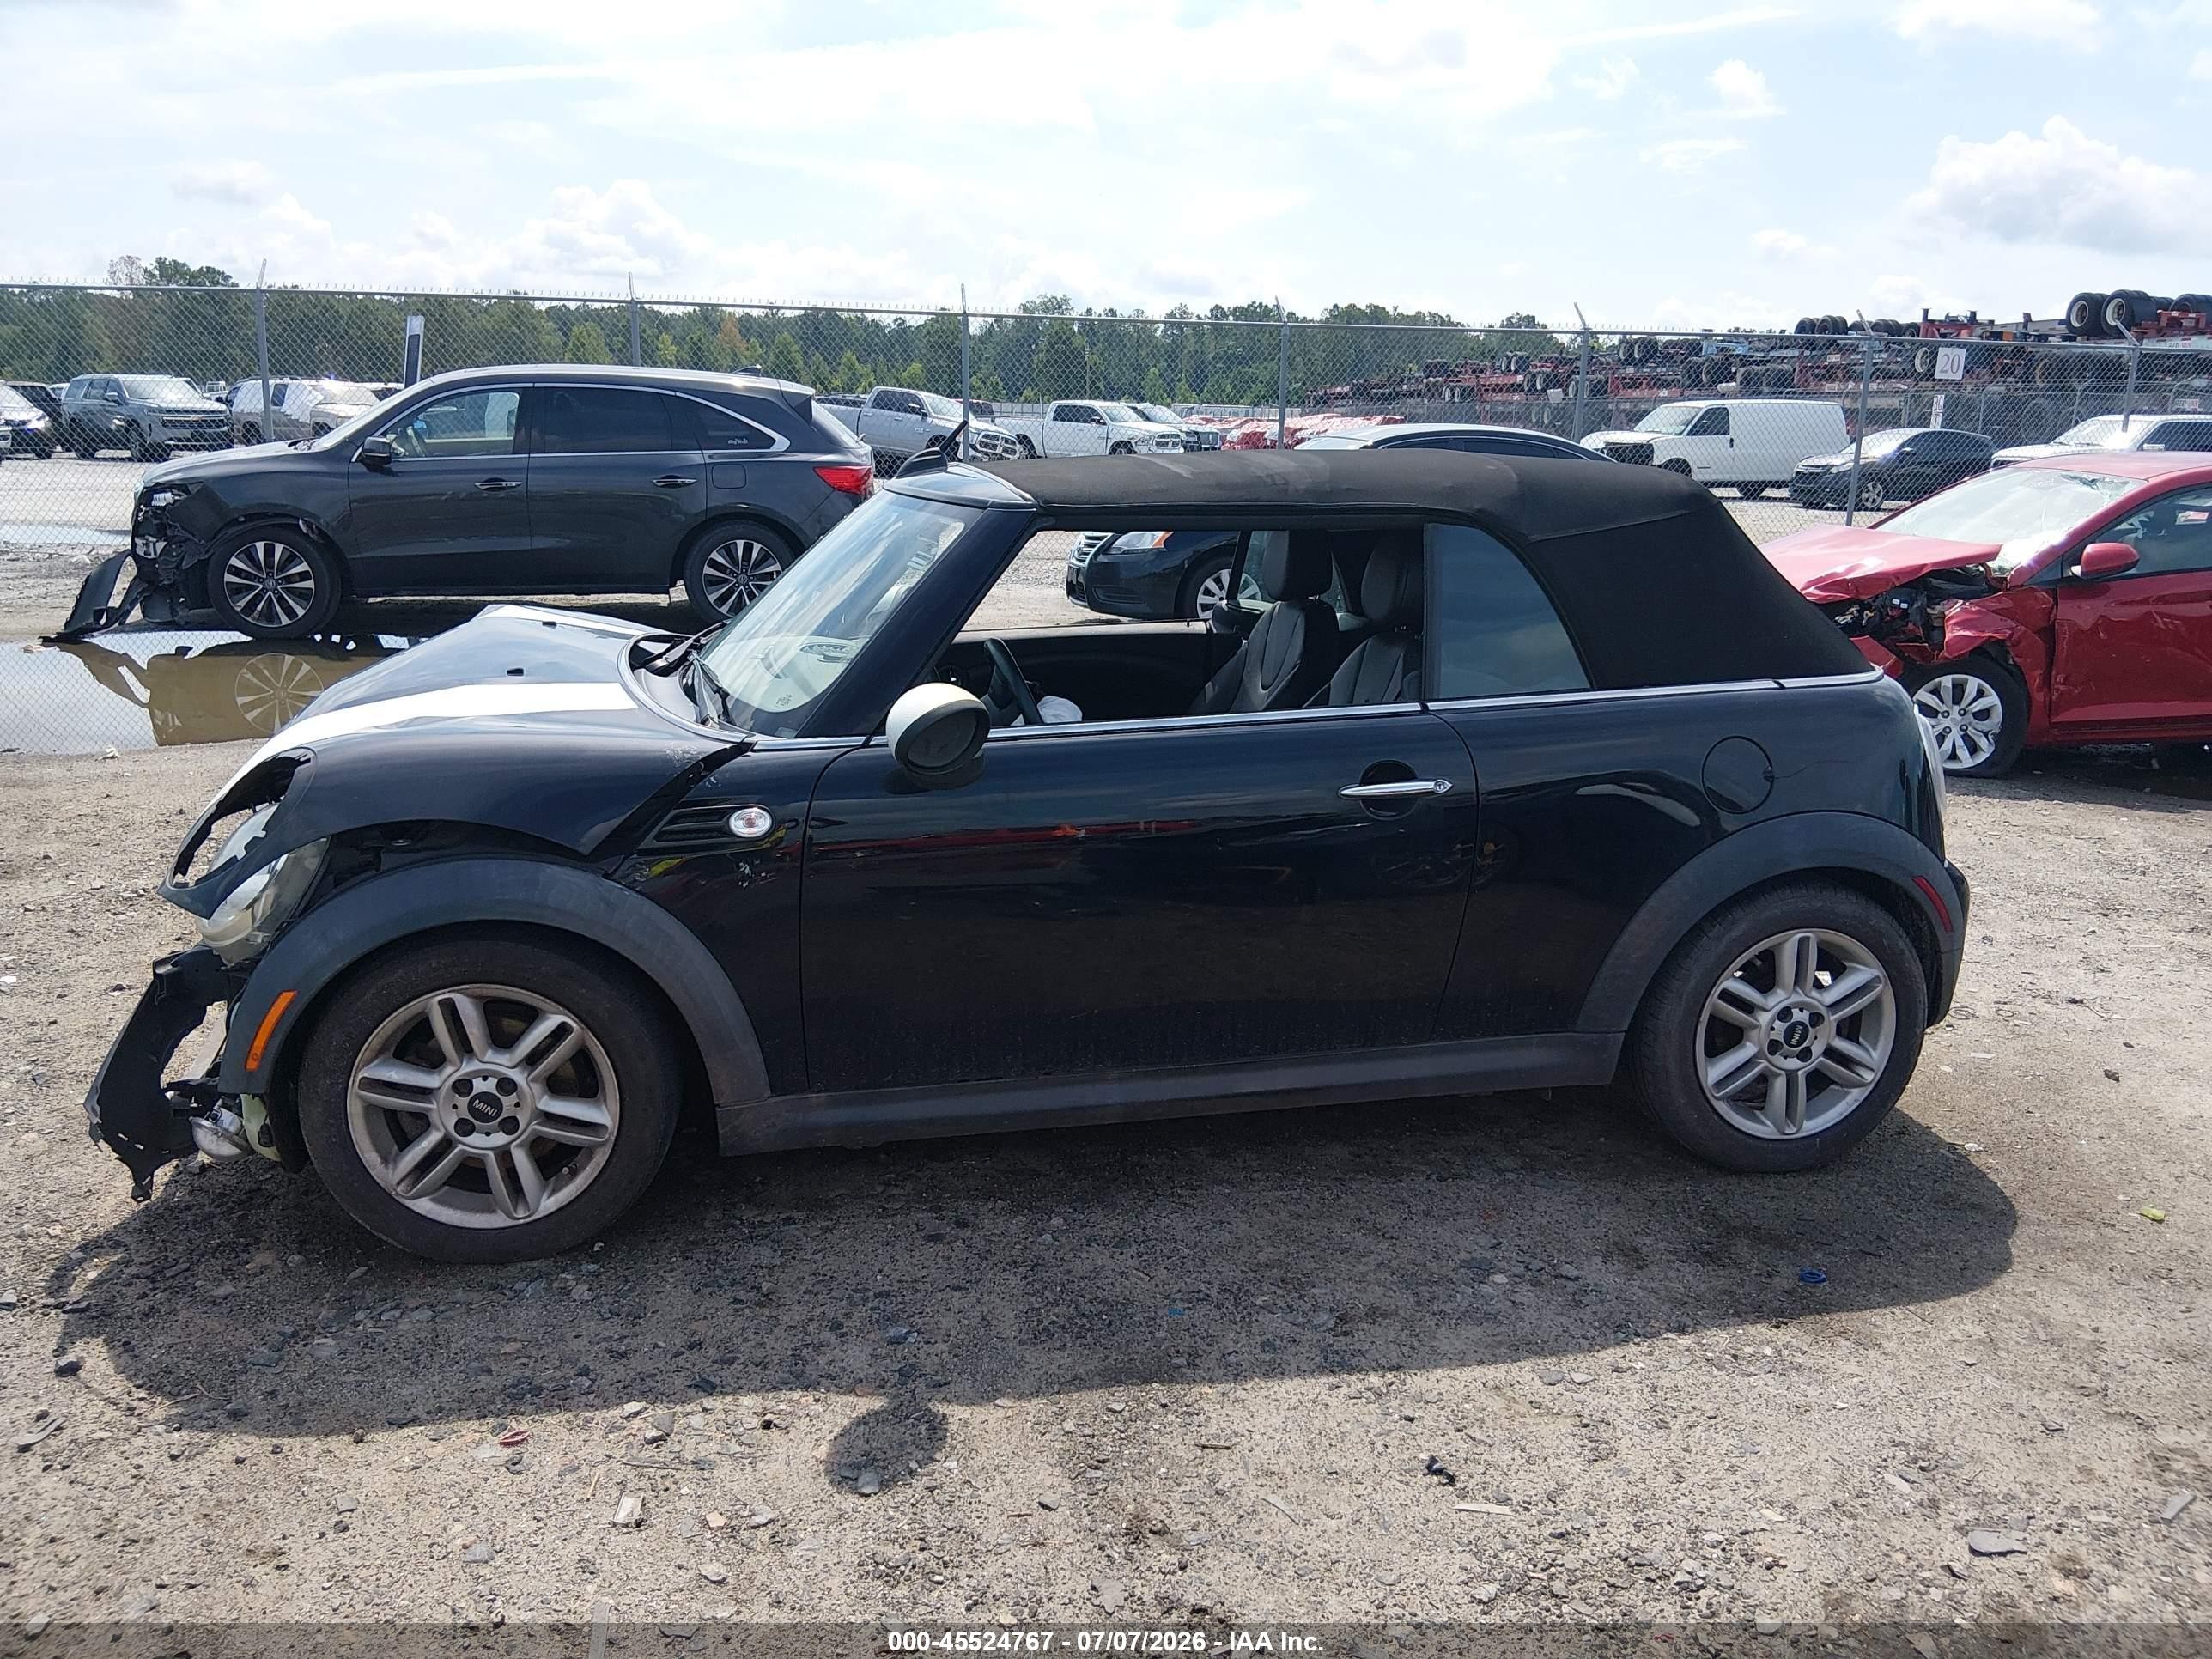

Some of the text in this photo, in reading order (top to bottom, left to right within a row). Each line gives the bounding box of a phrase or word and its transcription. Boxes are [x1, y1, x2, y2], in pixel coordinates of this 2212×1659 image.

[1939, 354, 1961, 374] 20
[1790, 1024, 1803, 1045] MINI
[472, 1098, 498, 1117] MINI
